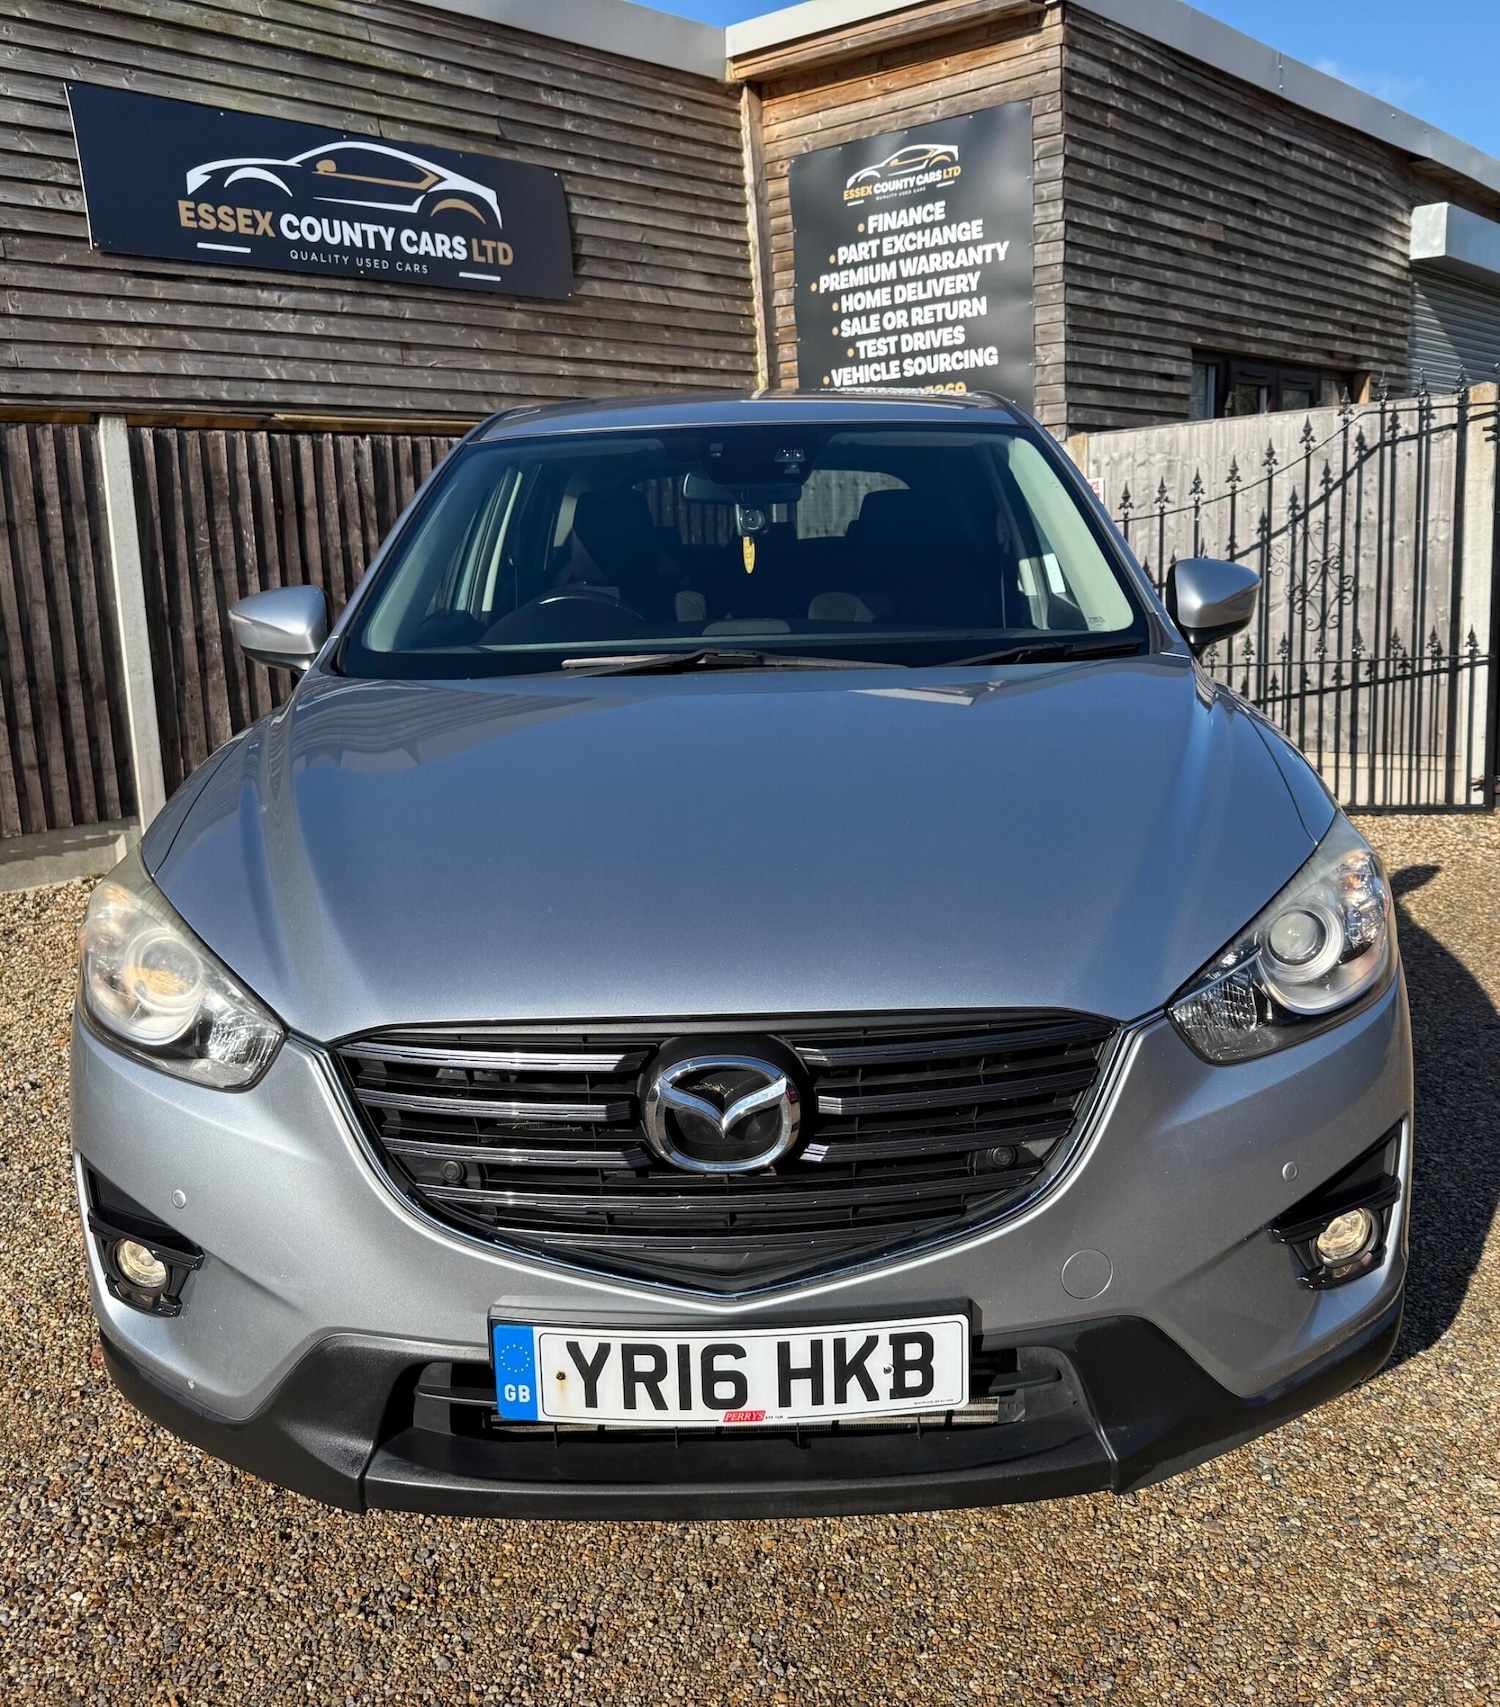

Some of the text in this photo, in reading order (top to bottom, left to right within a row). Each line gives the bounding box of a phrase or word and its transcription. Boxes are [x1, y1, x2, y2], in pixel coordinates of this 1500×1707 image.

[843, 165, 962, 201] ESSEX COUNTY CARS LTD
[178, 200, 514, 266] ESSEX COUNTY CARS LTD
[867, 201, 946, 234] FINANCE
[289, 249, 428, 274] QUALITY USED CARS
[837, 219, 983, 266] PART EXCHANGE
[819, 241, 1010, 294] PREMIUM WARRANTY
[841, 272, 981, 313] HOME DELIVERY
[840, 296, 988, 338] SALE OR RETURN
[856, 325, 966, 359] TEST DRIVES
[831, 346, 999, 387] VEHICLE SOURCING
[566, 1331, 935, 1411] YR16 HKB
[504, 1383, 531, 1403] GB
[725, 1411, 765, 1421] PERRYS
